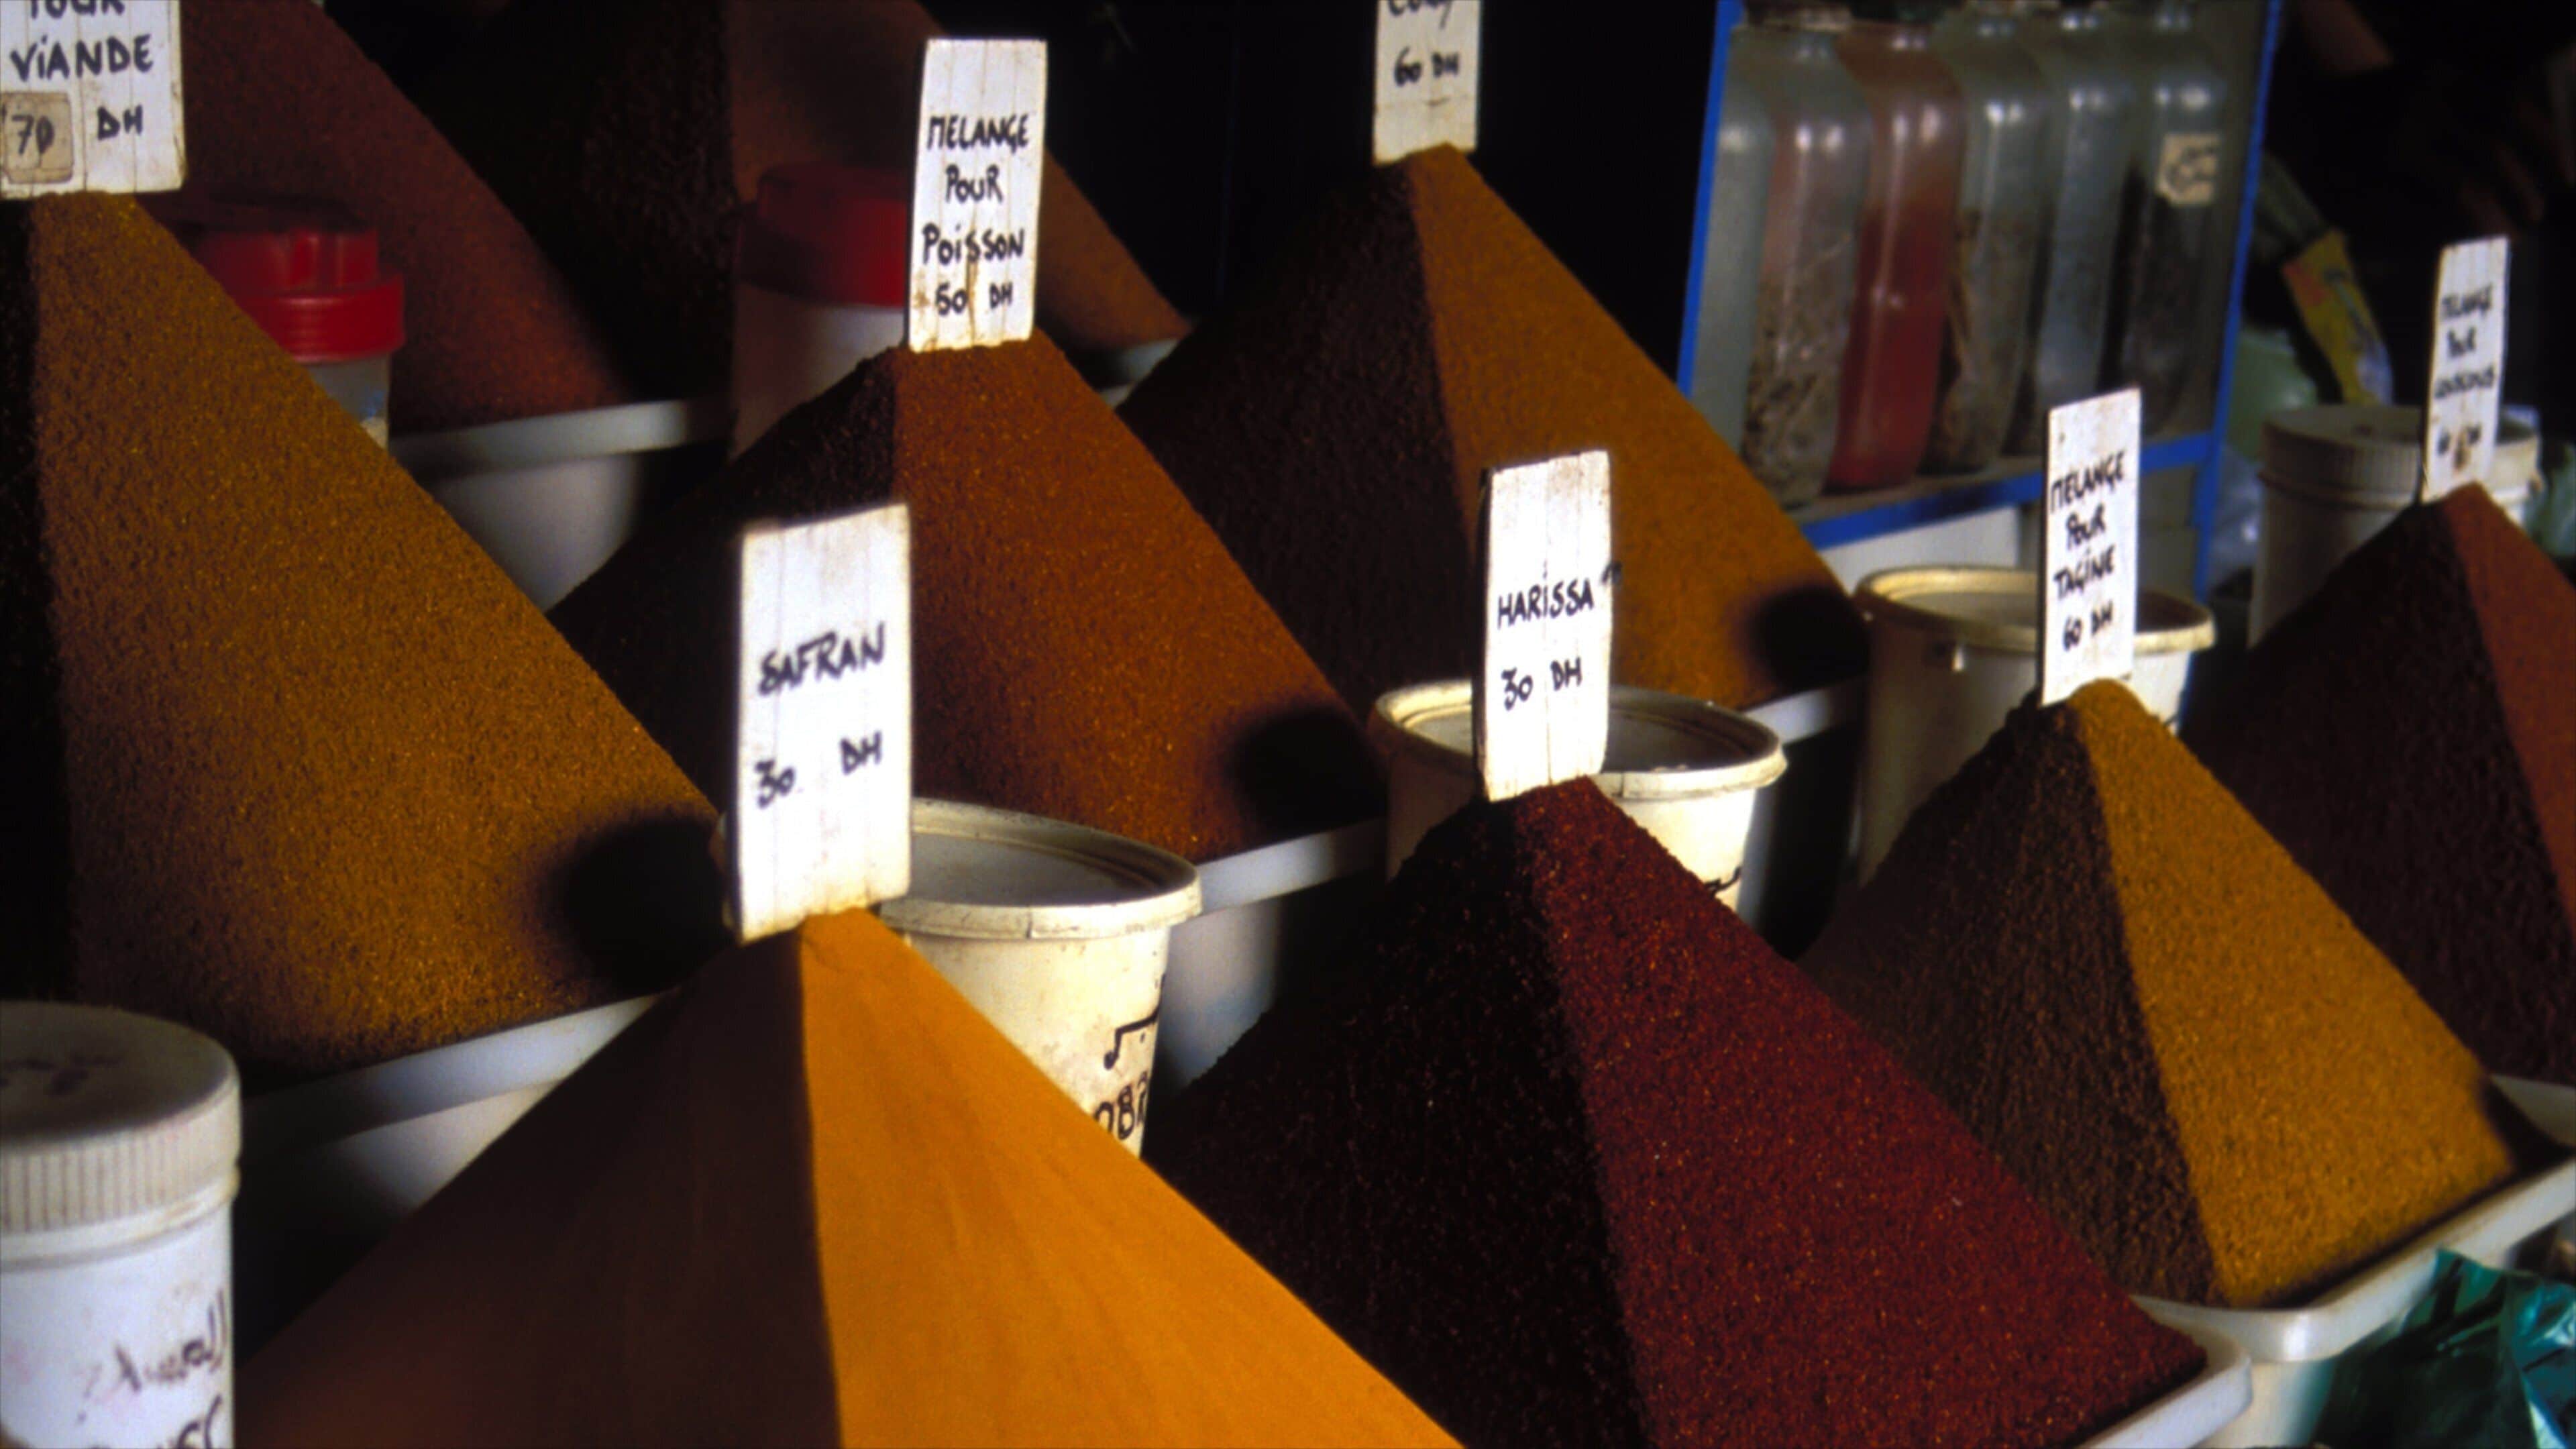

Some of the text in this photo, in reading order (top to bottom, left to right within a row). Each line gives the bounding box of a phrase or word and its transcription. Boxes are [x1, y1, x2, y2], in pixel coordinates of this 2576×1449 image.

[1395, 46, 1460, 87] 60 DH
[12, 103, 144, 156] 70 DH
[926, 113, 1029, 154] MELANGE
[945, 164, 1004, 204] POUR
[989, 280, 1014, 310] DH
[2050, 450, 2125, 514] MELANGE
[2063, 598, 2114, 652] 60 DH
[759, 621, 885, 697] SAFRAN
[1501, 655, 1582, 712] 30 DH
[755, 729, 883, 810] 30 DH
